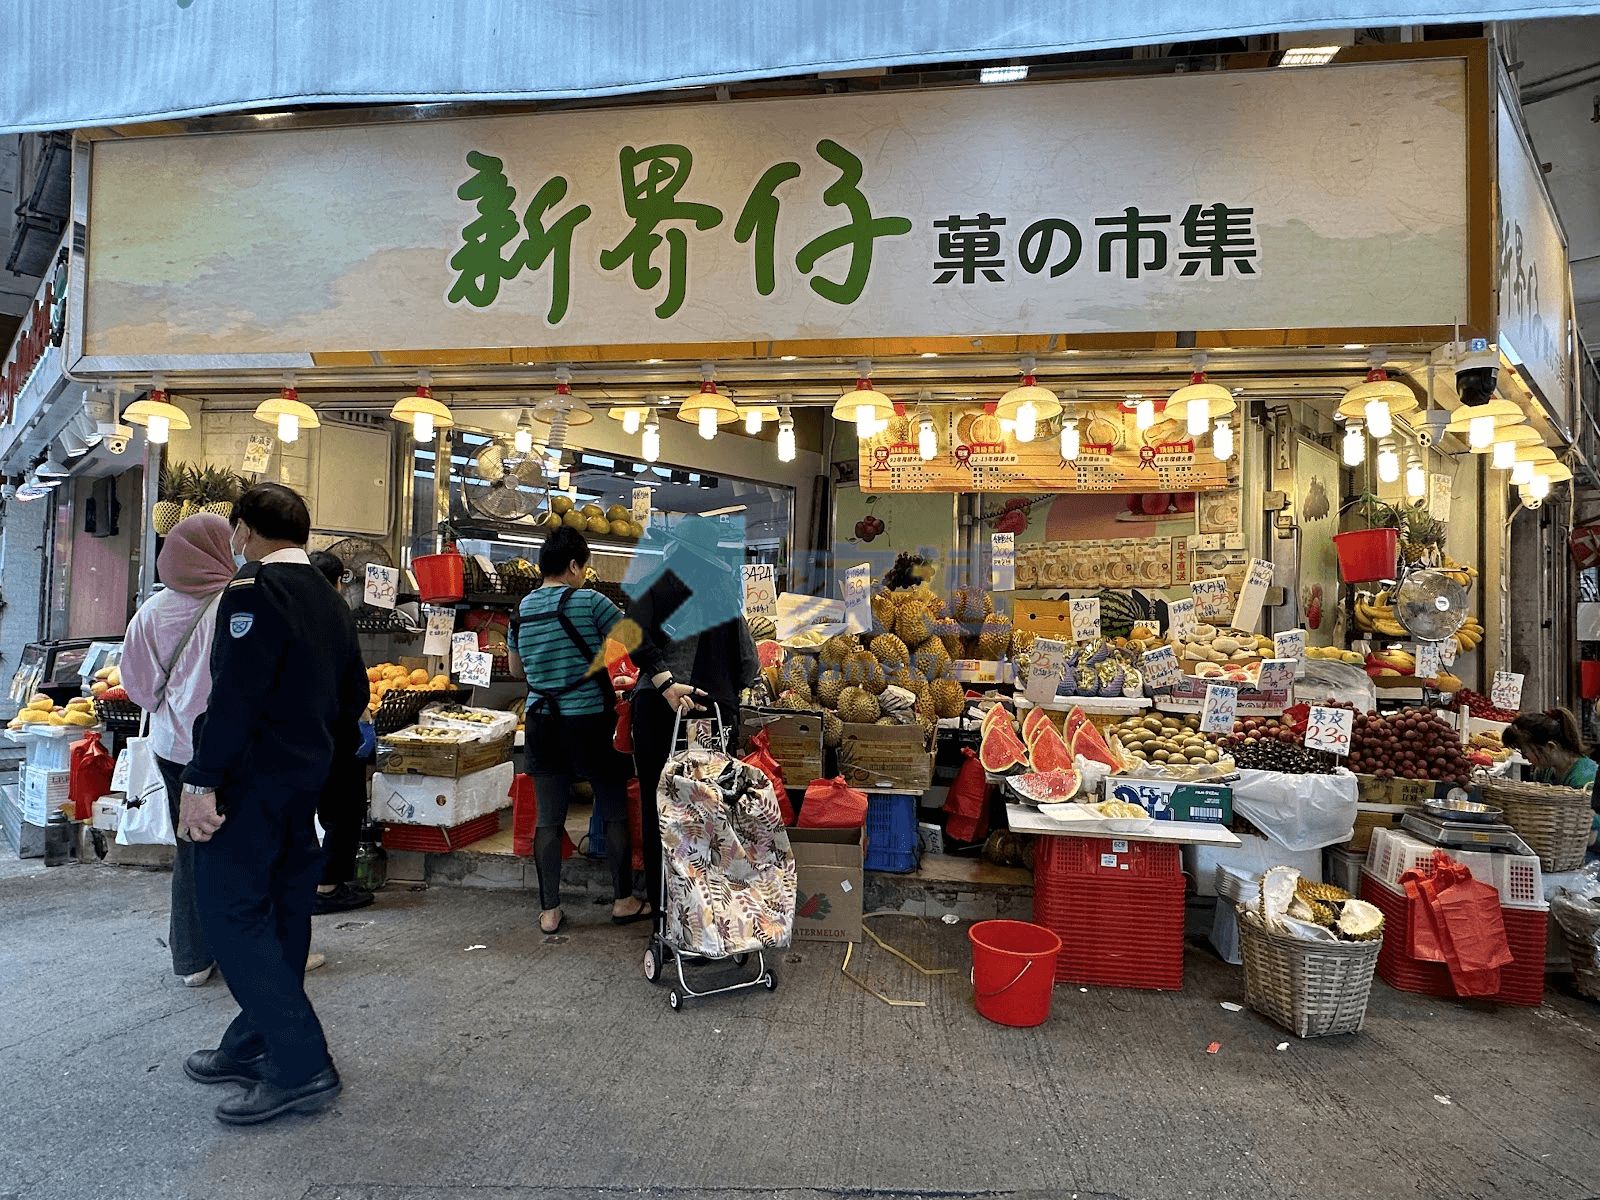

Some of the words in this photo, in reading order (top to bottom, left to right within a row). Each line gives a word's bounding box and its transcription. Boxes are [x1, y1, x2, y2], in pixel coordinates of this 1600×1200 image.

[448, 139, 911, 323] 新界仔
[932, 204, 1257, 283] 菓の市集
[1311, 707, 1344, 731] 黃皮
[793, 929, 846, 938] ATERMELON
